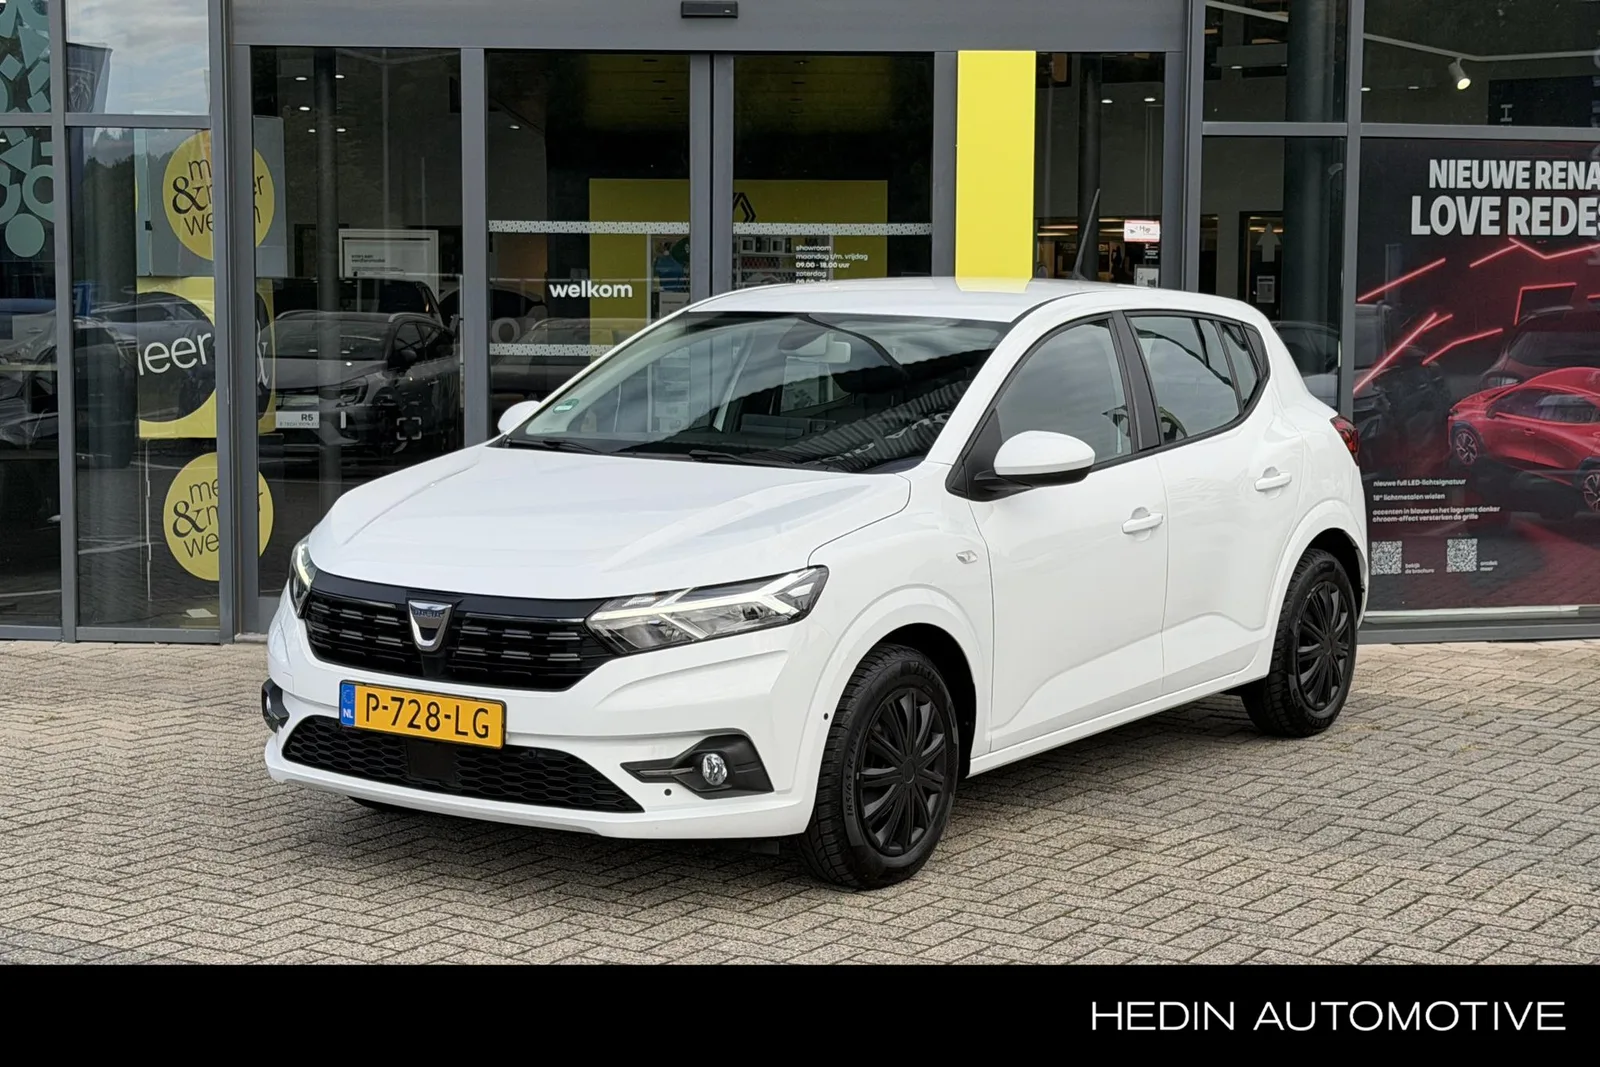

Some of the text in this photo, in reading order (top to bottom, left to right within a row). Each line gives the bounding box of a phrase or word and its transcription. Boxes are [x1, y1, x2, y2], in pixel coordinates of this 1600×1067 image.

[1429, 159, 1600, 190] NIEUWE RENA
[1411, 195, 1600, 237] LOVE REDE
[795, 253, 829, 261] maandag
[845, 253, 868, 261] vrijdag
[795, 270, 827, 278] zaterdag
[549, 280, 633, 298] welkom
[301, 413, 314, 421] R5
[1383, 493, 1424, 501] lichtmetalen
[1372, 508, 1403, 516] accenten
[1450, 506, 1464, 515] logo
[1462, 513, 1479, 521] grille
[343, 708, 354, 719] NL
[366, 692, 489, 739] P-728-LG
